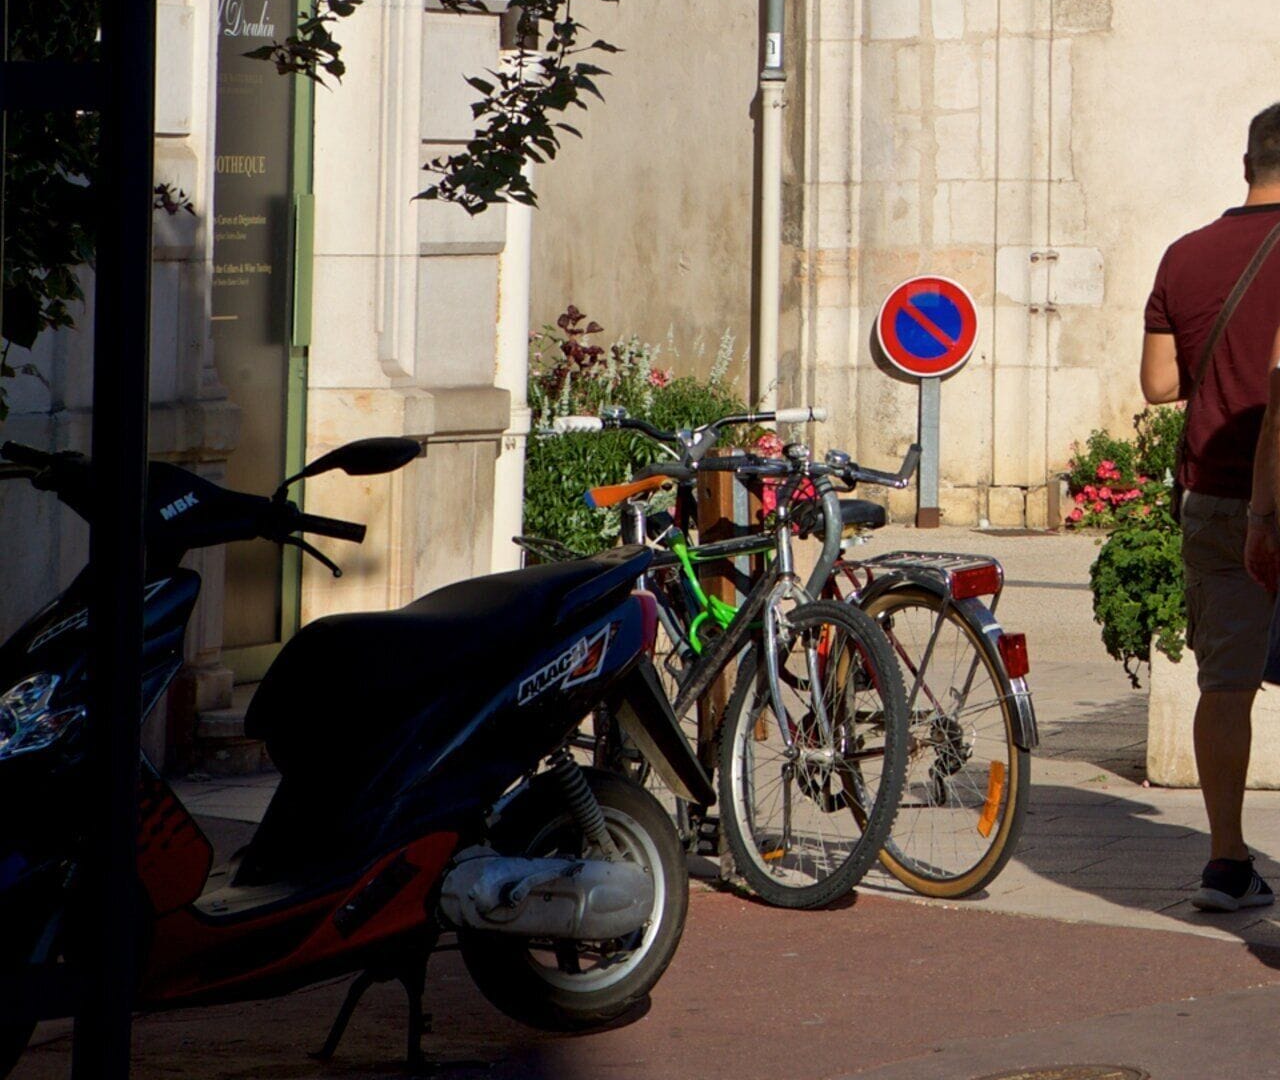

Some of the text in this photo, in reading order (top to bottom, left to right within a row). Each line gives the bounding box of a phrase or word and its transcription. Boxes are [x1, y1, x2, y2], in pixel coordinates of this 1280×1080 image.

[214, 155, 266, 177] OTHEQUE
[159, 491, 200, 521] MBK
[520, 638, 587, 701] MACH
